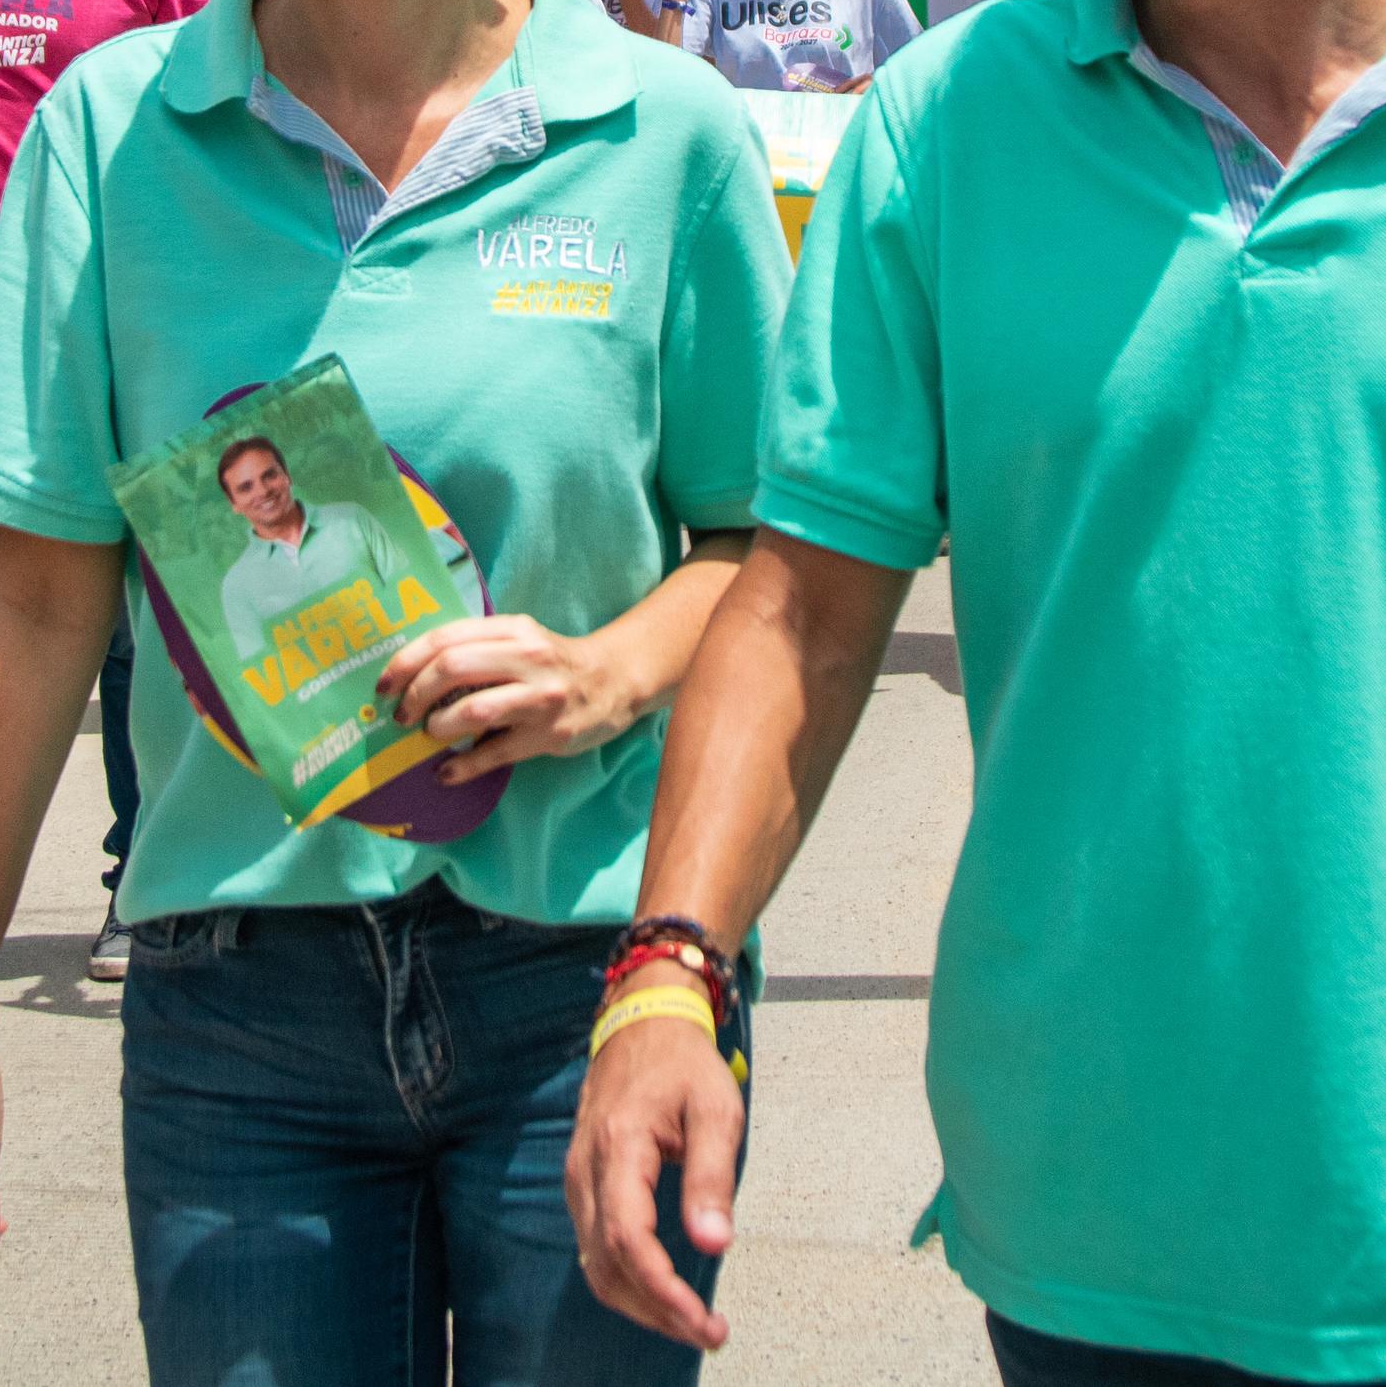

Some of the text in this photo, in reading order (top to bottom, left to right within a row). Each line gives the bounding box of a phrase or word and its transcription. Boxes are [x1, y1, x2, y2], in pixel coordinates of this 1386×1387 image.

[764, 27, 833, 44] Barraza
[800, 38, 818, 46] 2027
[508, 213, 598, 236] ALFREDO
[477, 228, 628, 280] VARELA
[241, 576, 441, 706] VARELA
